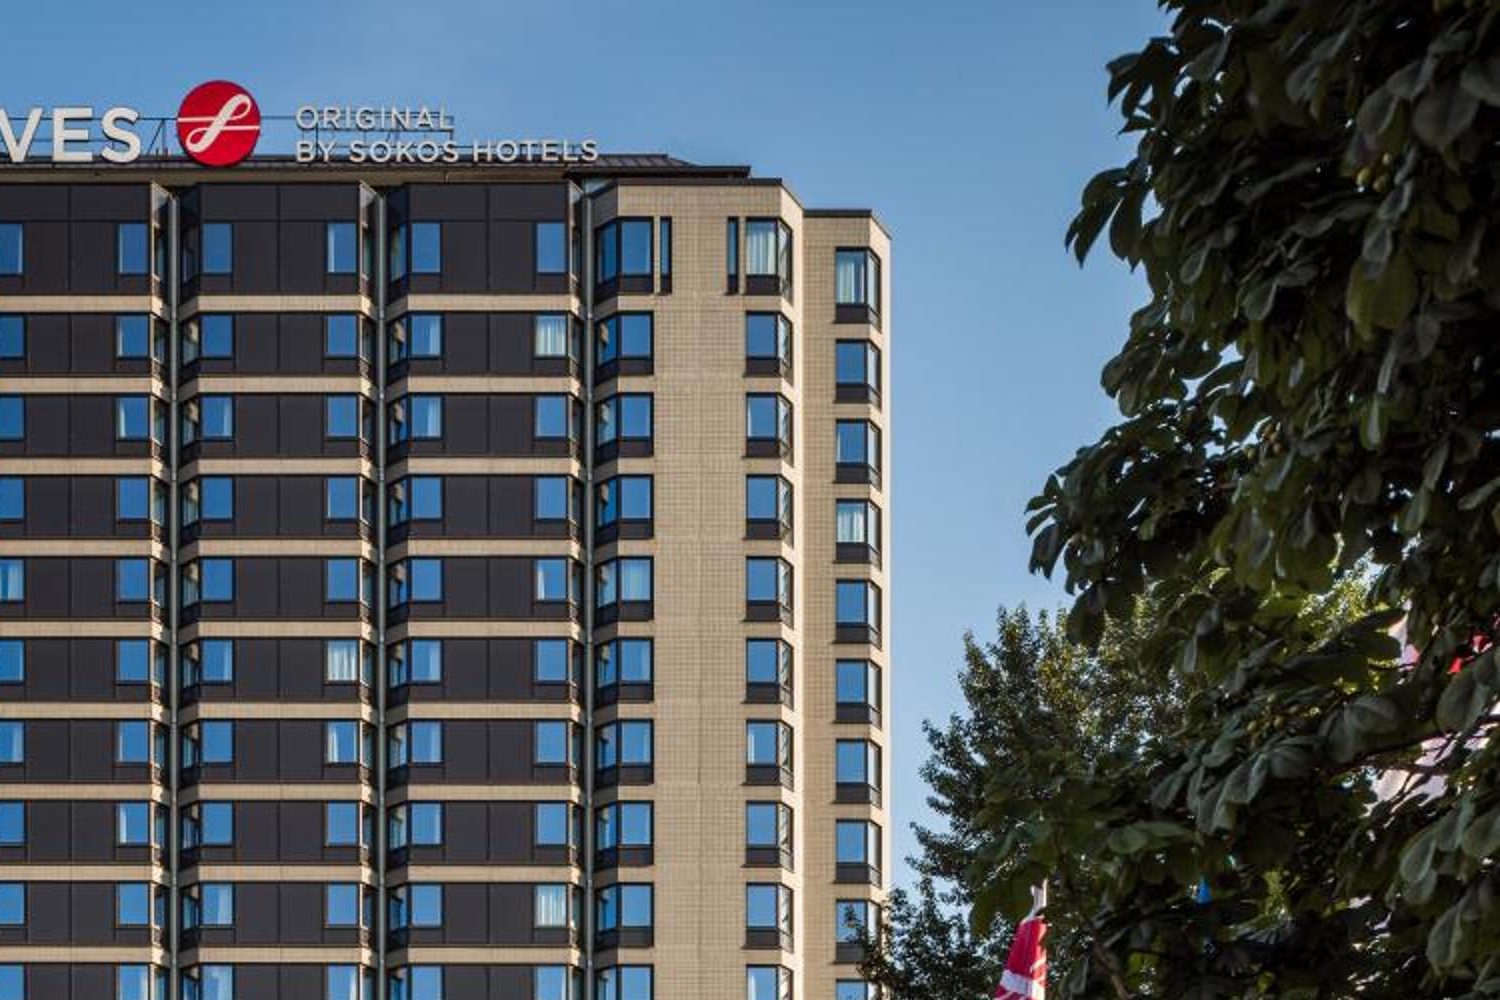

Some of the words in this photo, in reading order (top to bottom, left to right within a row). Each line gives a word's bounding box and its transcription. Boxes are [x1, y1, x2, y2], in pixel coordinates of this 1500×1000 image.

[295, 105, 454, 130] ORIGINAL
[296, 141, 336, 163] BY
[350, 140, 458, 163] SOKOS
[473, 139, 599, 163] HOTELS
